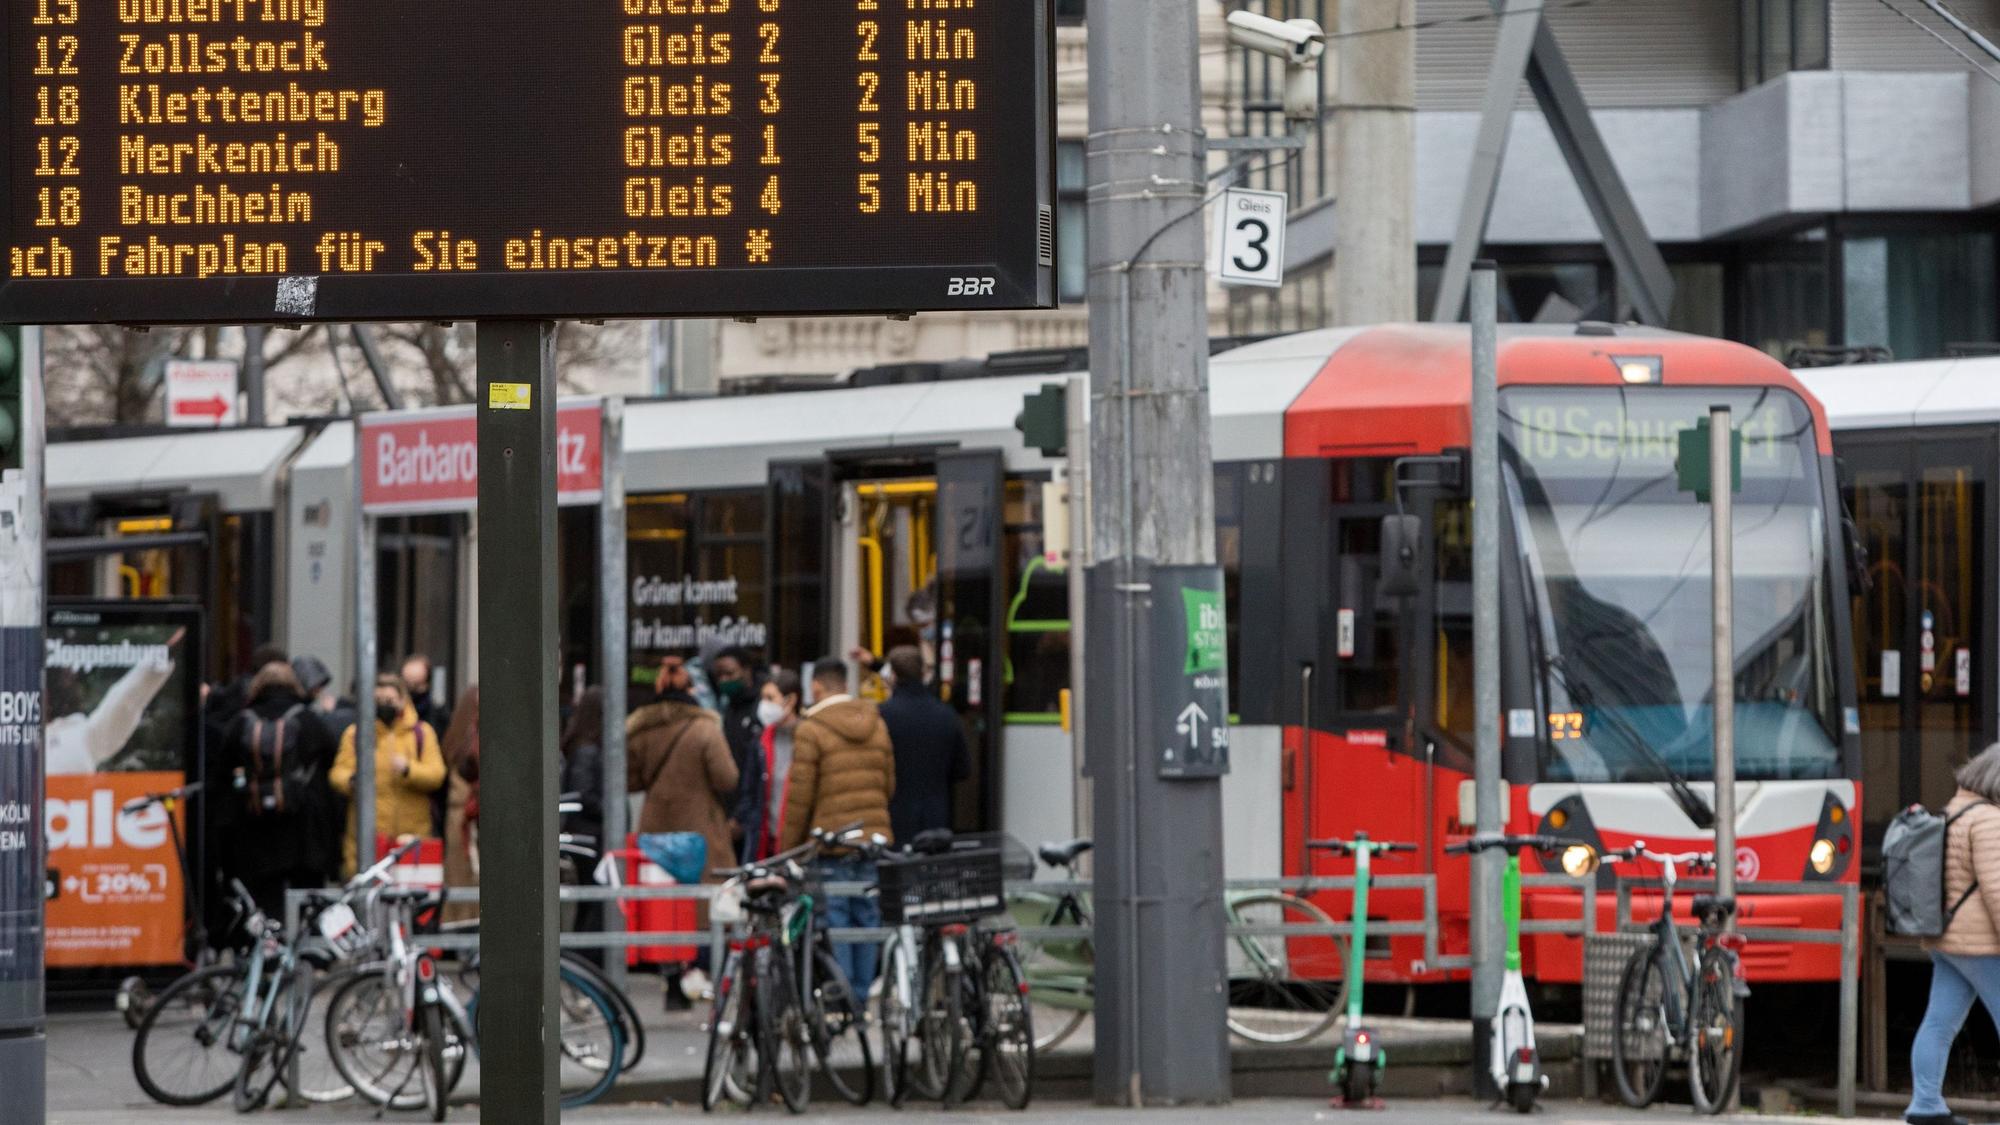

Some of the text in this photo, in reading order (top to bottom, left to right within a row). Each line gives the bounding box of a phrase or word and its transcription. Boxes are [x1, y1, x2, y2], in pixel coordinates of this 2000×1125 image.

[34, 19, 974, 75] 12 Zollstock Gleis 2 2 Min
[34, 70, 975, 127] 18 Klettenberg Gleis 3 2 Min
[35, 121, 976, 176] 12 Merkenich Gleis 1 5 Min
[35, 172, 976, 226] 18 Buchheim Gleis 4 5 Min
[1237, 197, 1272, 214] Gleis
[100, 234, 287, 279] Fahrplan
[315, 232, 385, 272] für
[413, 231, 477, 271] Sie
[505, 229, 717, 269] einsetzen
[1233, 218, 1269, 273] 3
[947, 277, 996, 296] BBR
[1518, 405, 1558, 459] 18
[377, 427, 586, 487] Barbarotz
[632, 573, 738, 606] Grüner kommt
[653, 618, 694, 649] kaum
[0, 691, 41, 723] BOYS
[0, 725, 21, 746] ITS
[0, 800, 31, 824] KÖLN
[0, 831, 26, 850] ENA
